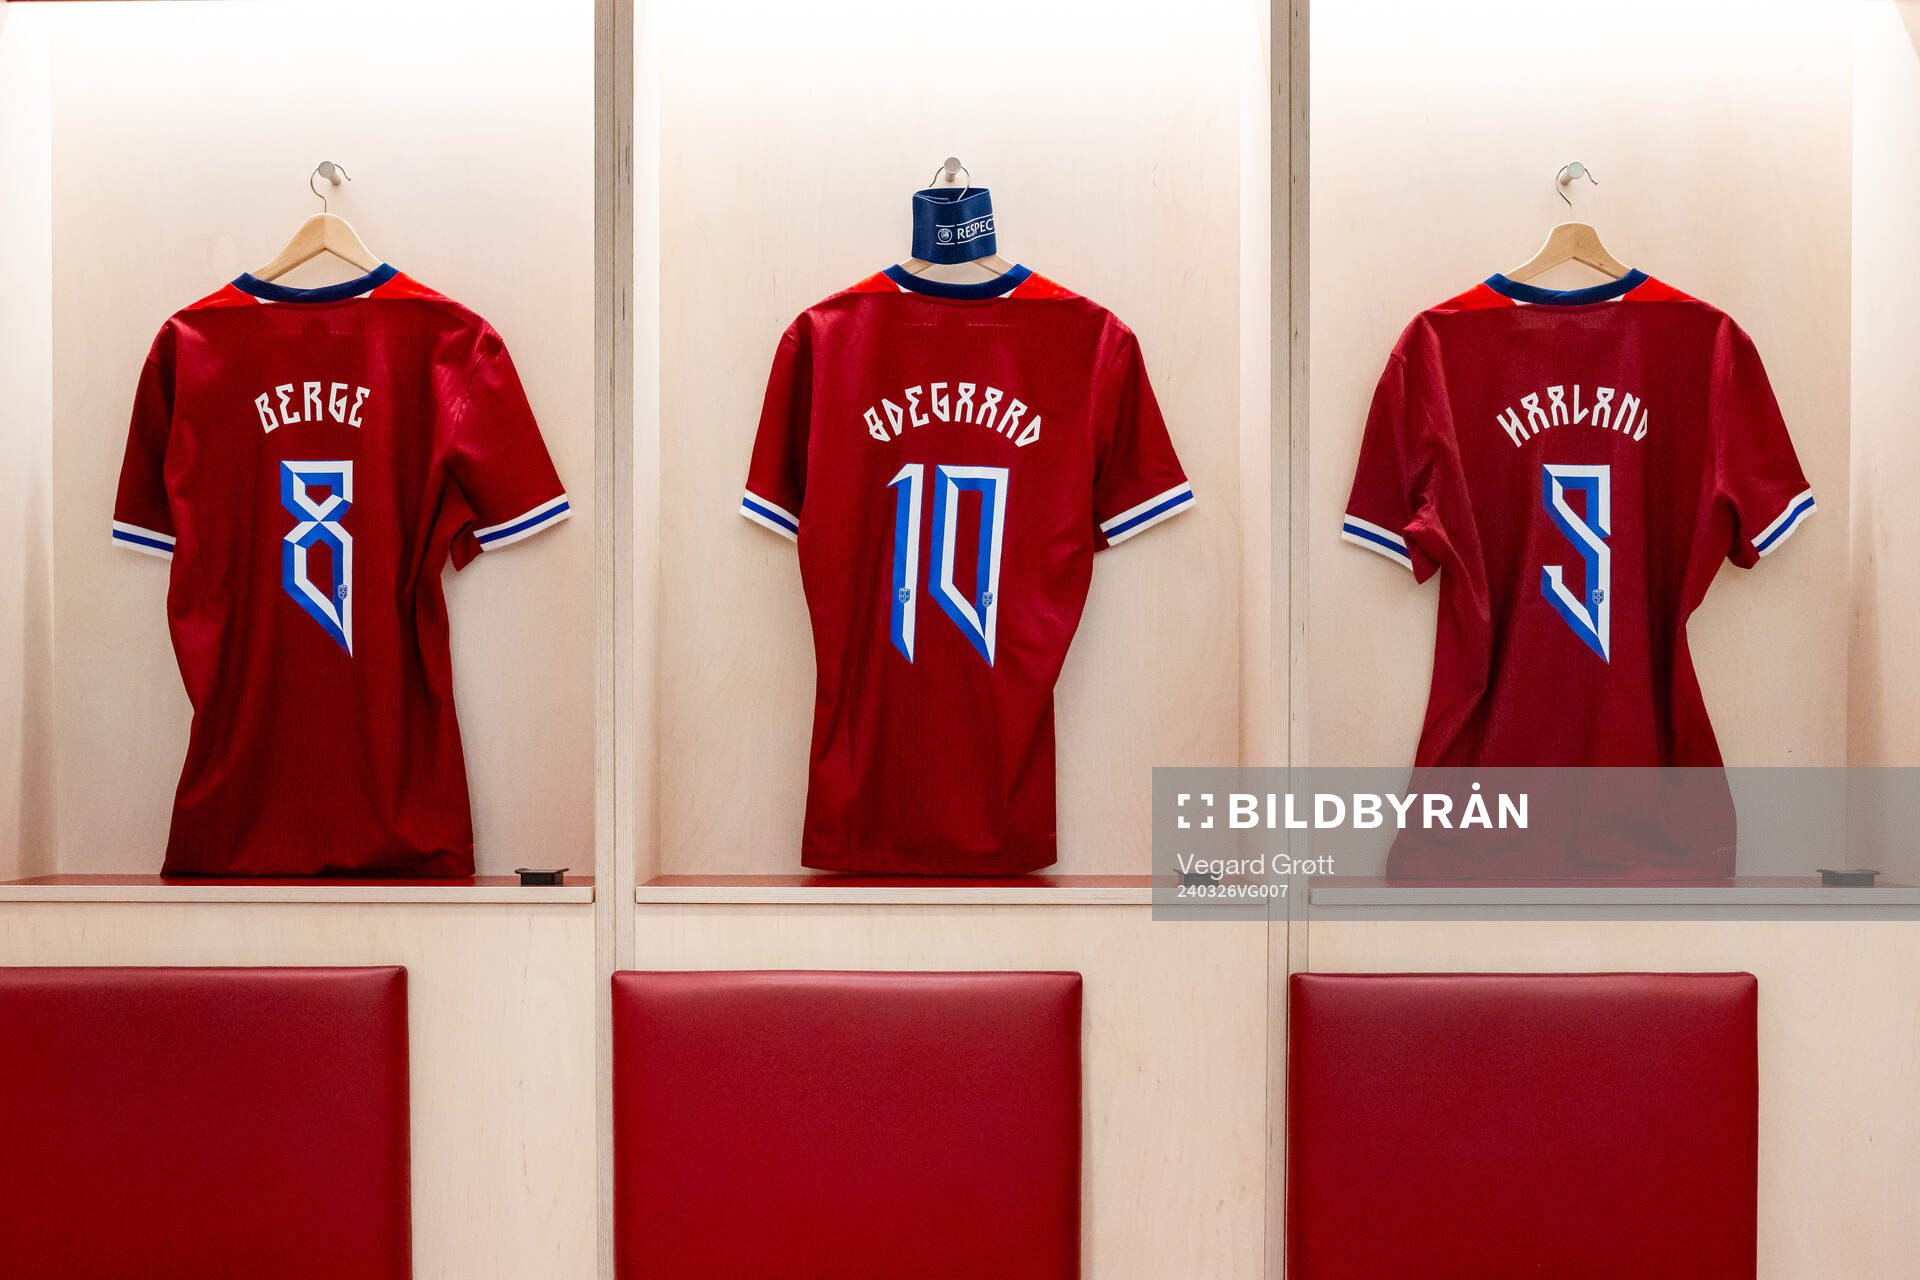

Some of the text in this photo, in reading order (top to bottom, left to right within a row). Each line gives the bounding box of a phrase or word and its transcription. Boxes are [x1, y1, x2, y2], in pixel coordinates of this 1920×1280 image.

[957, 218, 994, 240] RESPEC
[254, 381, 370, 434] BERGE
[1496, 384, 1648, 448] HAALAND
[280, 460, 353, 658] 8
[886, 463, 1009, 668] 10
[1540, 464, 1611, 664] 9
